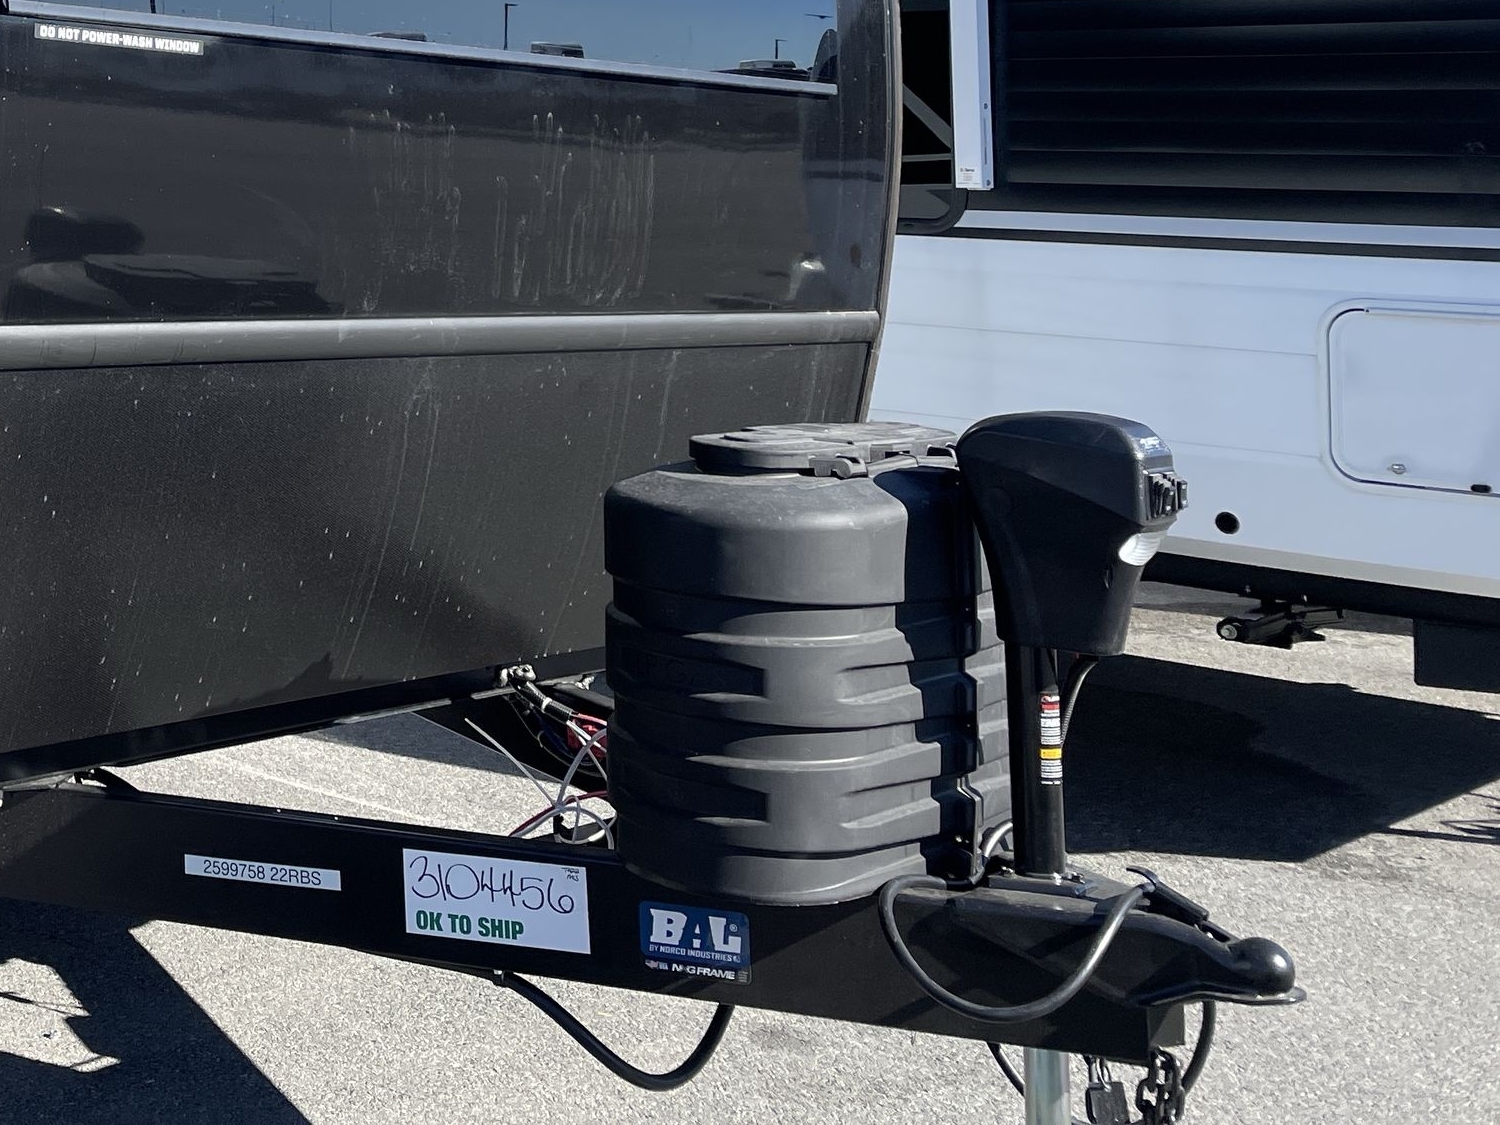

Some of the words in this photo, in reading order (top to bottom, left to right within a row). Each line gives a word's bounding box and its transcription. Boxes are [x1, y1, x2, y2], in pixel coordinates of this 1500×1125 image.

[39, 25, 56, 38] DO
[57, 26, 81, 41] NOT
[81, 29, 153, 48] POWER-WASH
[154, 37, 200, 54] WINDOW
[203, 859, 266, 881] 2599758
[270, 866, 322, 886] 22RBS
[409, 855, 575, 914] 3104456
[415, 909, 444, 932] OK
[448, 912, 472, 936] TO
[478, 916, 525, 941] SHIP
[649, 943, 659, 953] BY
[660, 944, 686, 957] NORCO
[687, 948, 733, 963] INDUSTRIES
